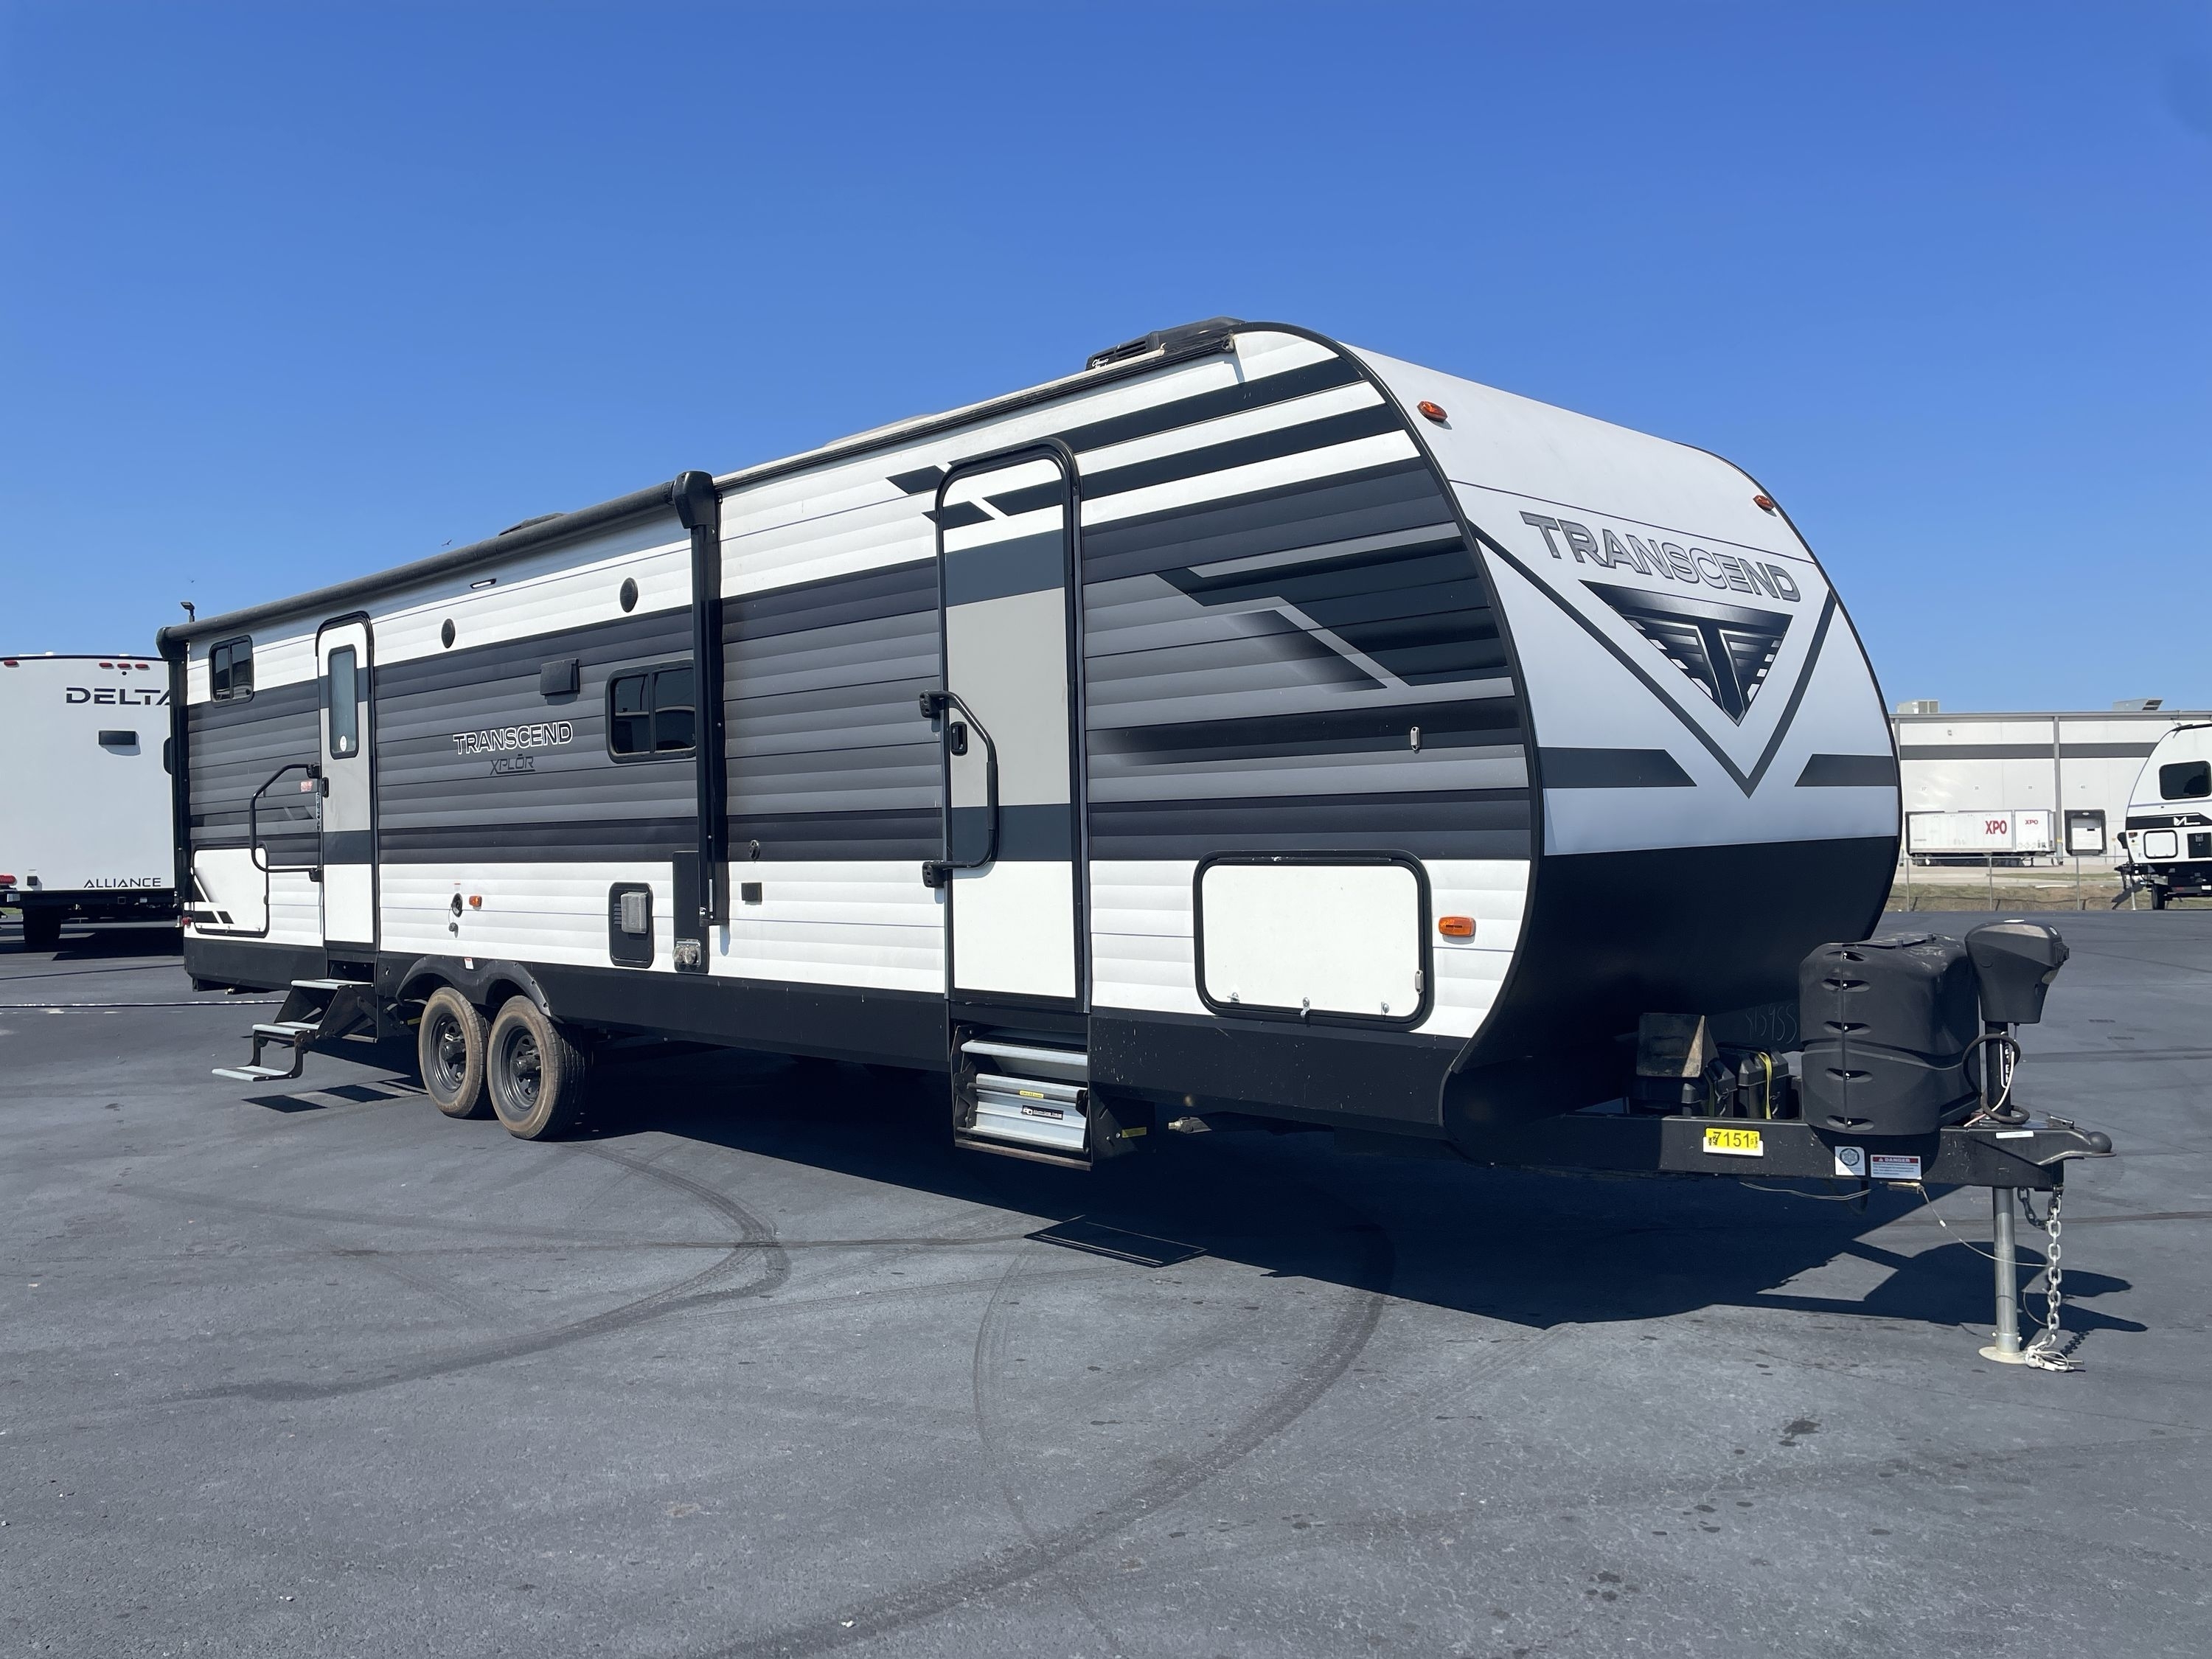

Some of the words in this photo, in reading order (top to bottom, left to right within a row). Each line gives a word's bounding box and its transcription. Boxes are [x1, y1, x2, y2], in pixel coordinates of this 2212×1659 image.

[1519, 510, 1801, 602] TRANSCEND
[453, 721, 573, 755] TRANSCEND
[1985, 820, 2007, 835] XPO
[83, 878, 161, 888] ALLIANCE
